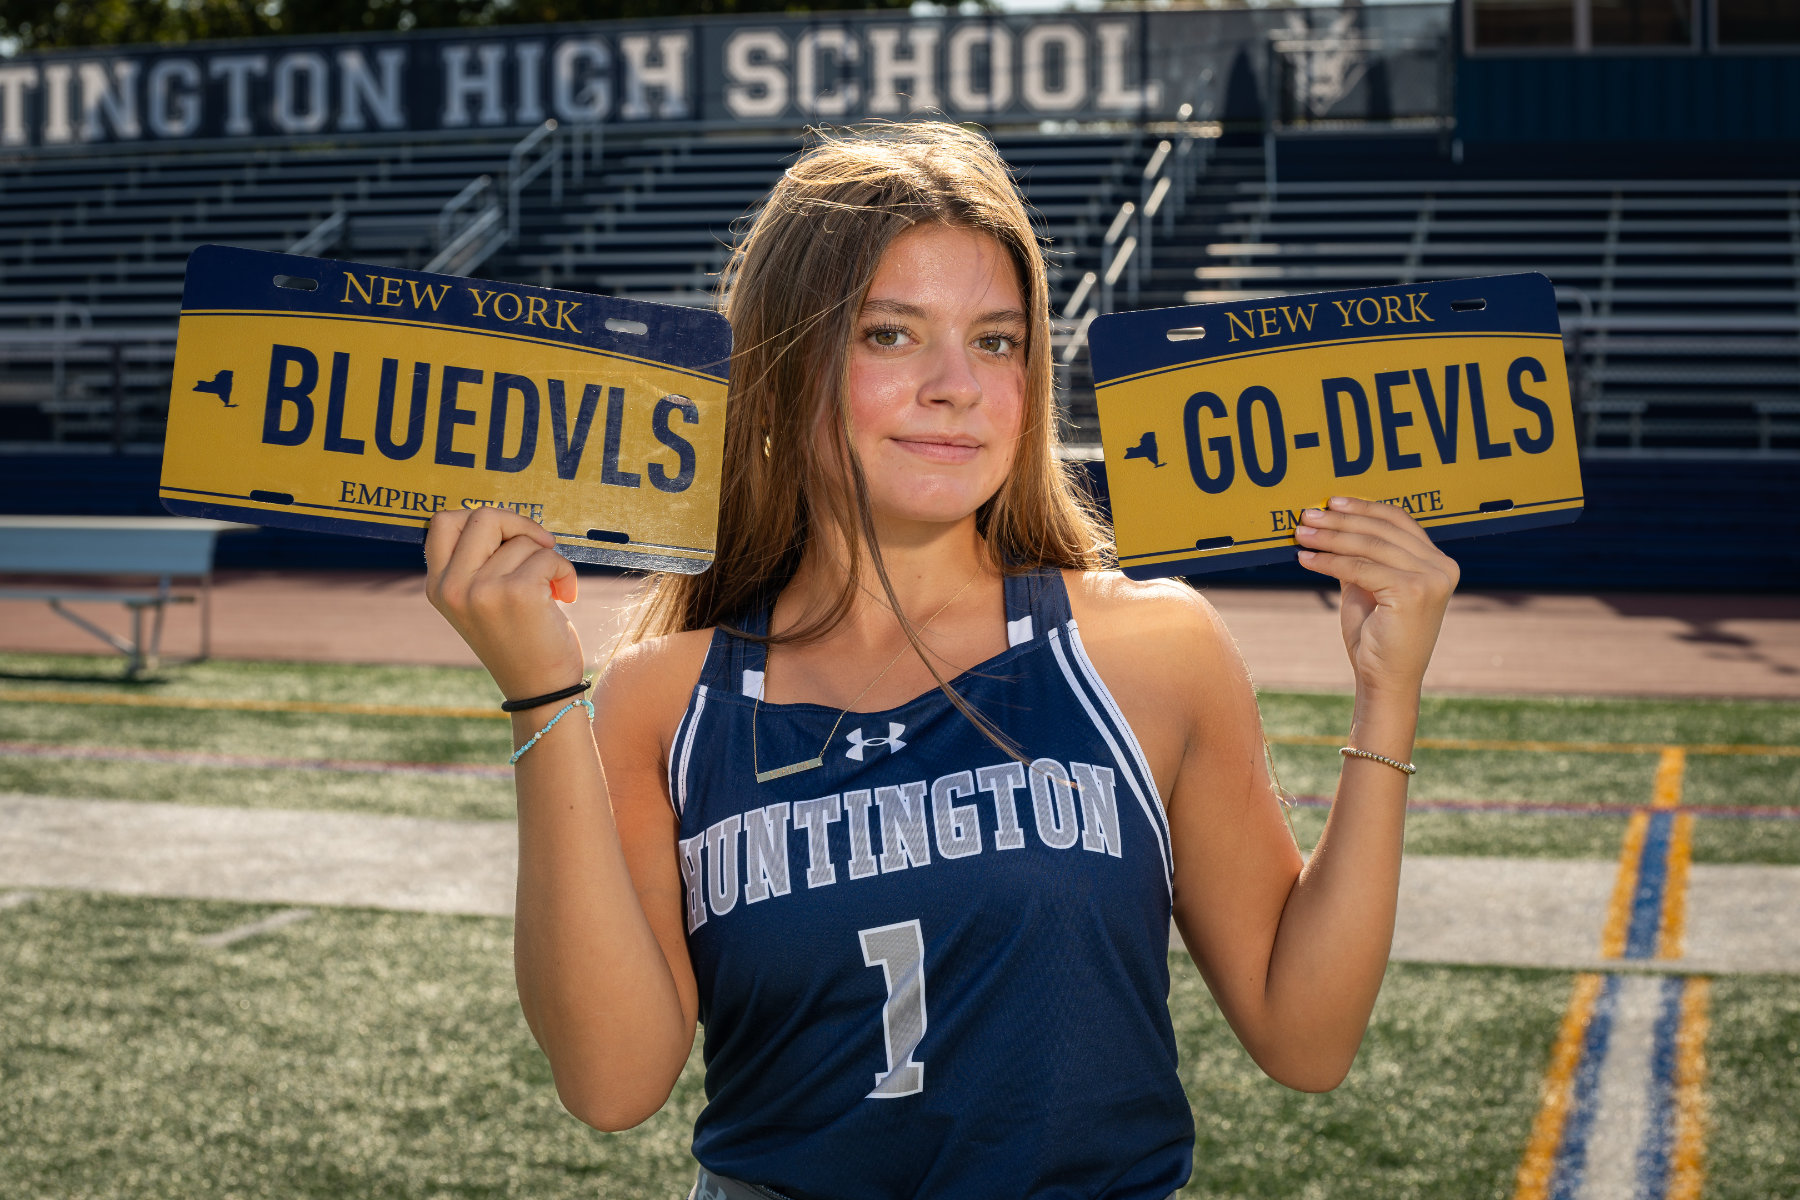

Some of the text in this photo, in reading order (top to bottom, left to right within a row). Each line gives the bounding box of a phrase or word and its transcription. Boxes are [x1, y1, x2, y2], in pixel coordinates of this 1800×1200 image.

[0, 23, 1161, 145] TINGTON HIGH SCHOOL
[340, 272, 583, 334] NEW YORK
[1225, 292, 1435, 343] NEW YORK
[262, 343, 700, 494] BLUEDVLS
[1182, 356, 1555, 494] GO-DEVLS
[338, 480, 447, 513] EMPIRE
[679, 758, 1122, 936] HUNTINGTON
[857, 918, 928, 1100] 1
